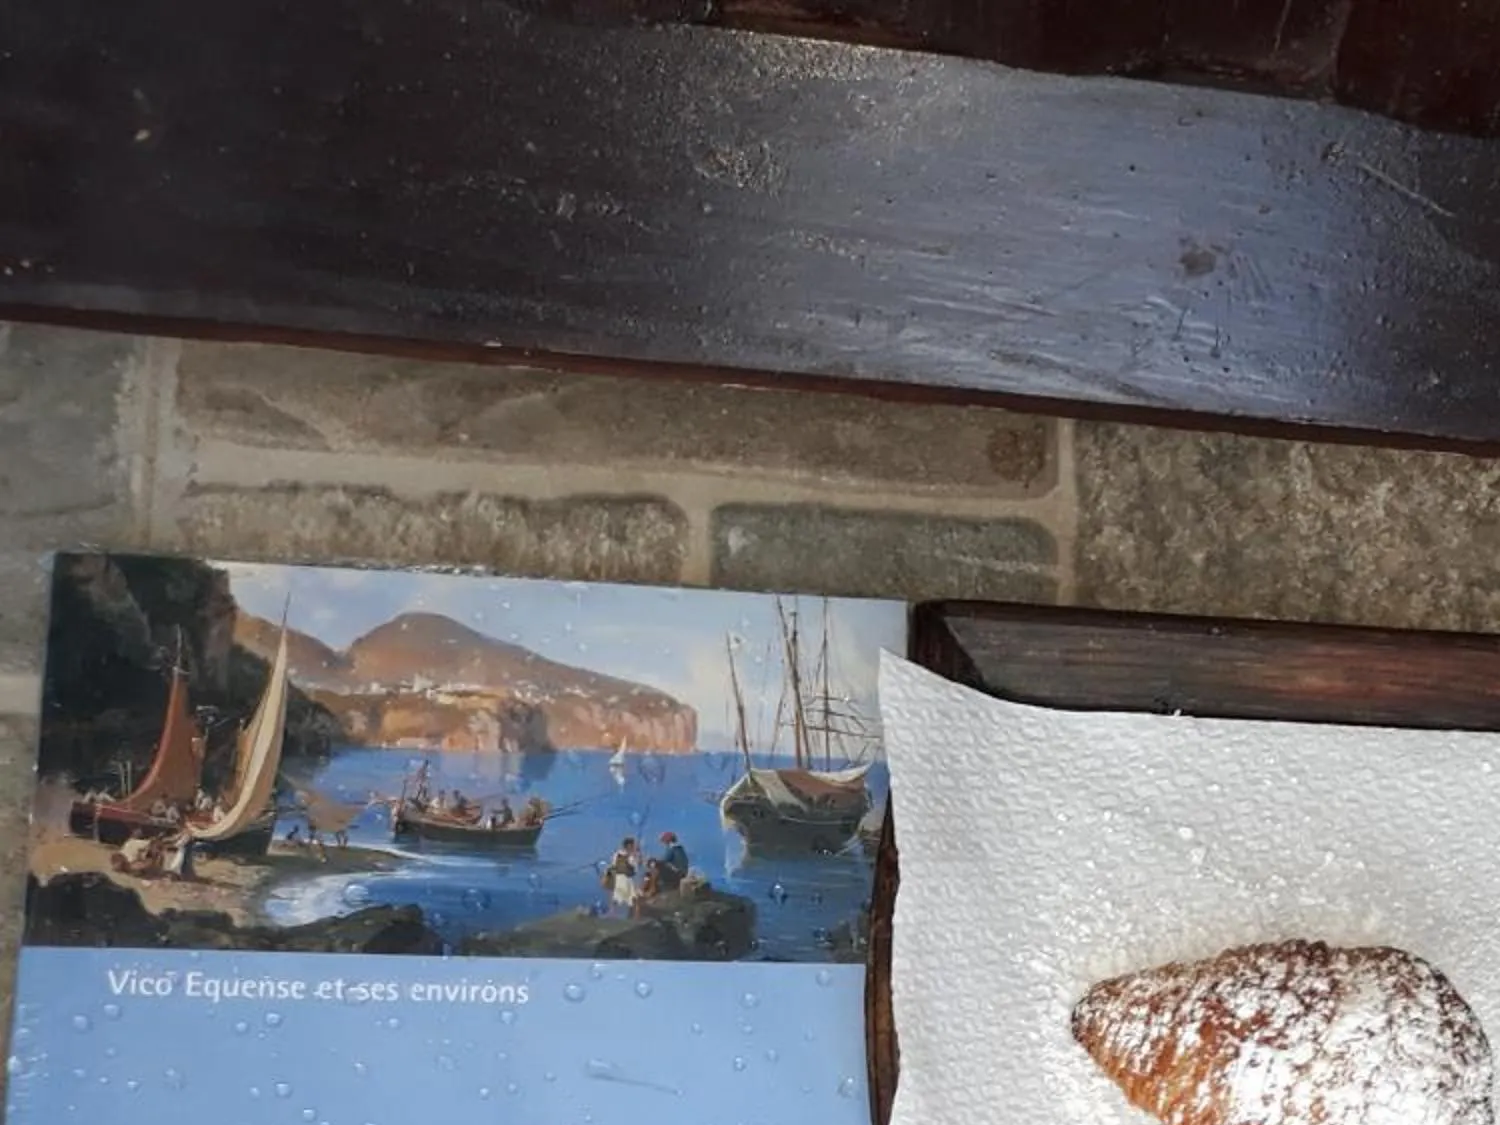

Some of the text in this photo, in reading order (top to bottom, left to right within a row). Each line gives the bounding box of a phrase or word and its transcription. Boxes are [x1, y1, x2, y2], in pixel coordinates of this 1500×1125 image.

[108, 968, 530, 1004] Vico Equense et ses environs
